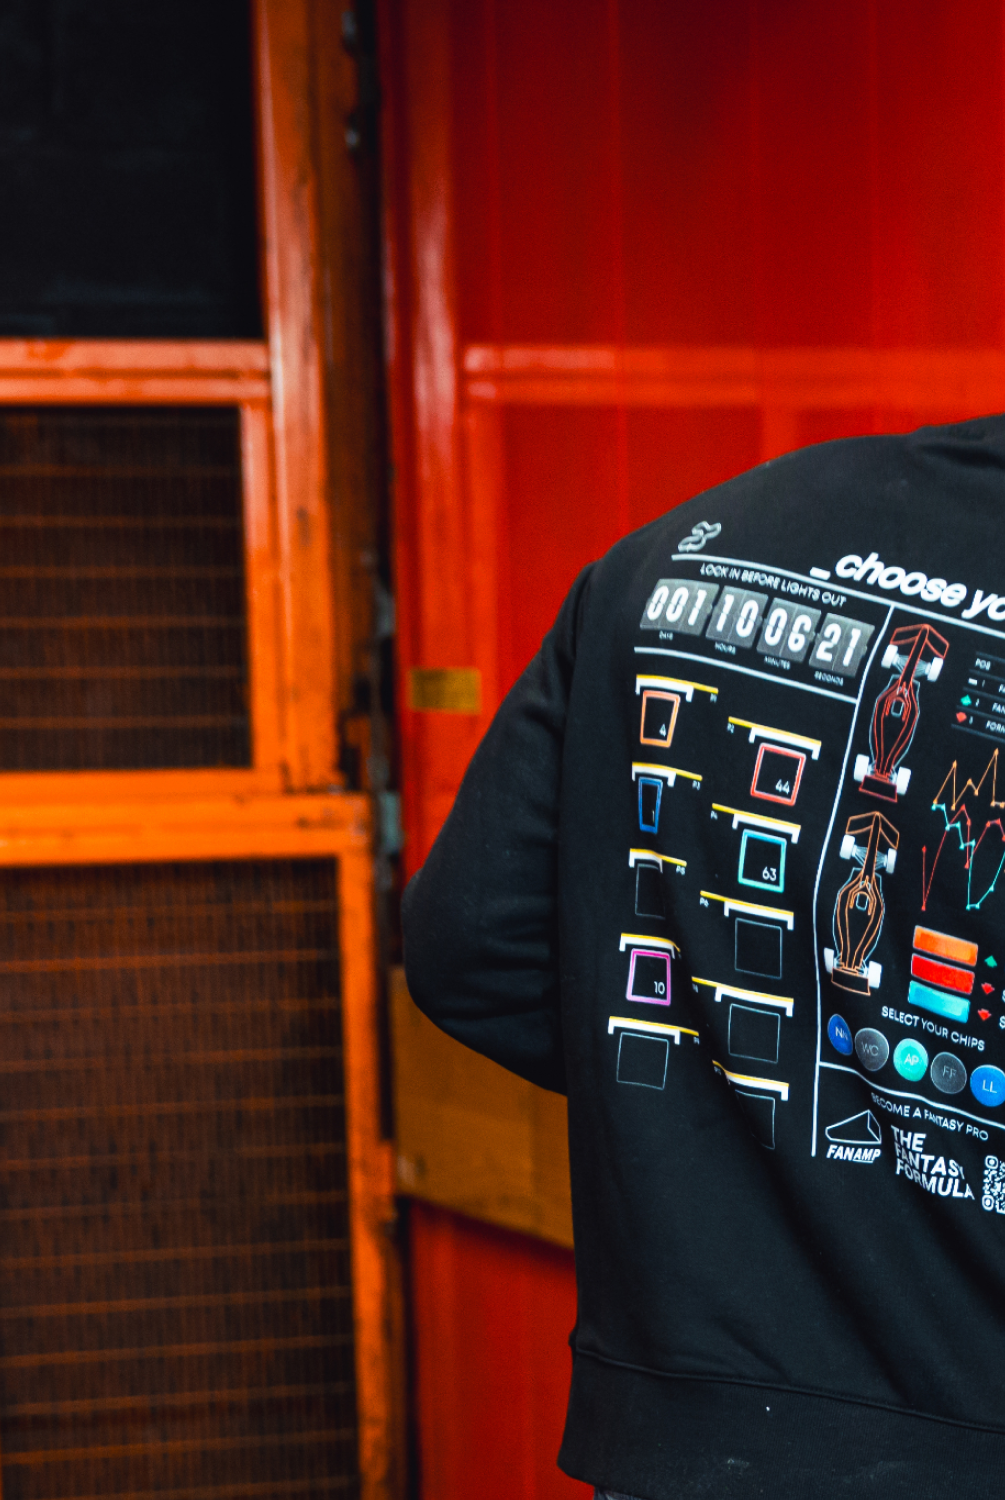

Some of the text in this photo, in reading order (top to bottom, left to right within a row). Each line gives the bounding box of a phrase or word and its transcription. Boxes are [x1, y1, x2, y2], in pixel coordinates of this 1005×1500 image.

[700, 562, 847, 608] LOCK IN BEFORE LIGHTS OUT
[646, 585, 862, 667] 001 10 06 21
[659, 723, 667, 737] 4
[775, 778, 791, 795] 44
[762, 866, 777, 882] 63
[653, 981, 666, 995] 10
[881, 1005, 985, 1051] SELECT YOUR CHIPS
[861, 1041, 879, 1057] WC
[904, 1053, 919, 1066] AP
[942, 1065, 957, 1079] FF
[981, 1078, 998, 1094] LL
[870, 1092, 989, 1141] BECOME A FANTASY PRO
[826, 1144, 881, 1163] FANAMP
[890, 1124, 927, 1153] THE
[895, 1157, 975, 1200] FORMULA
